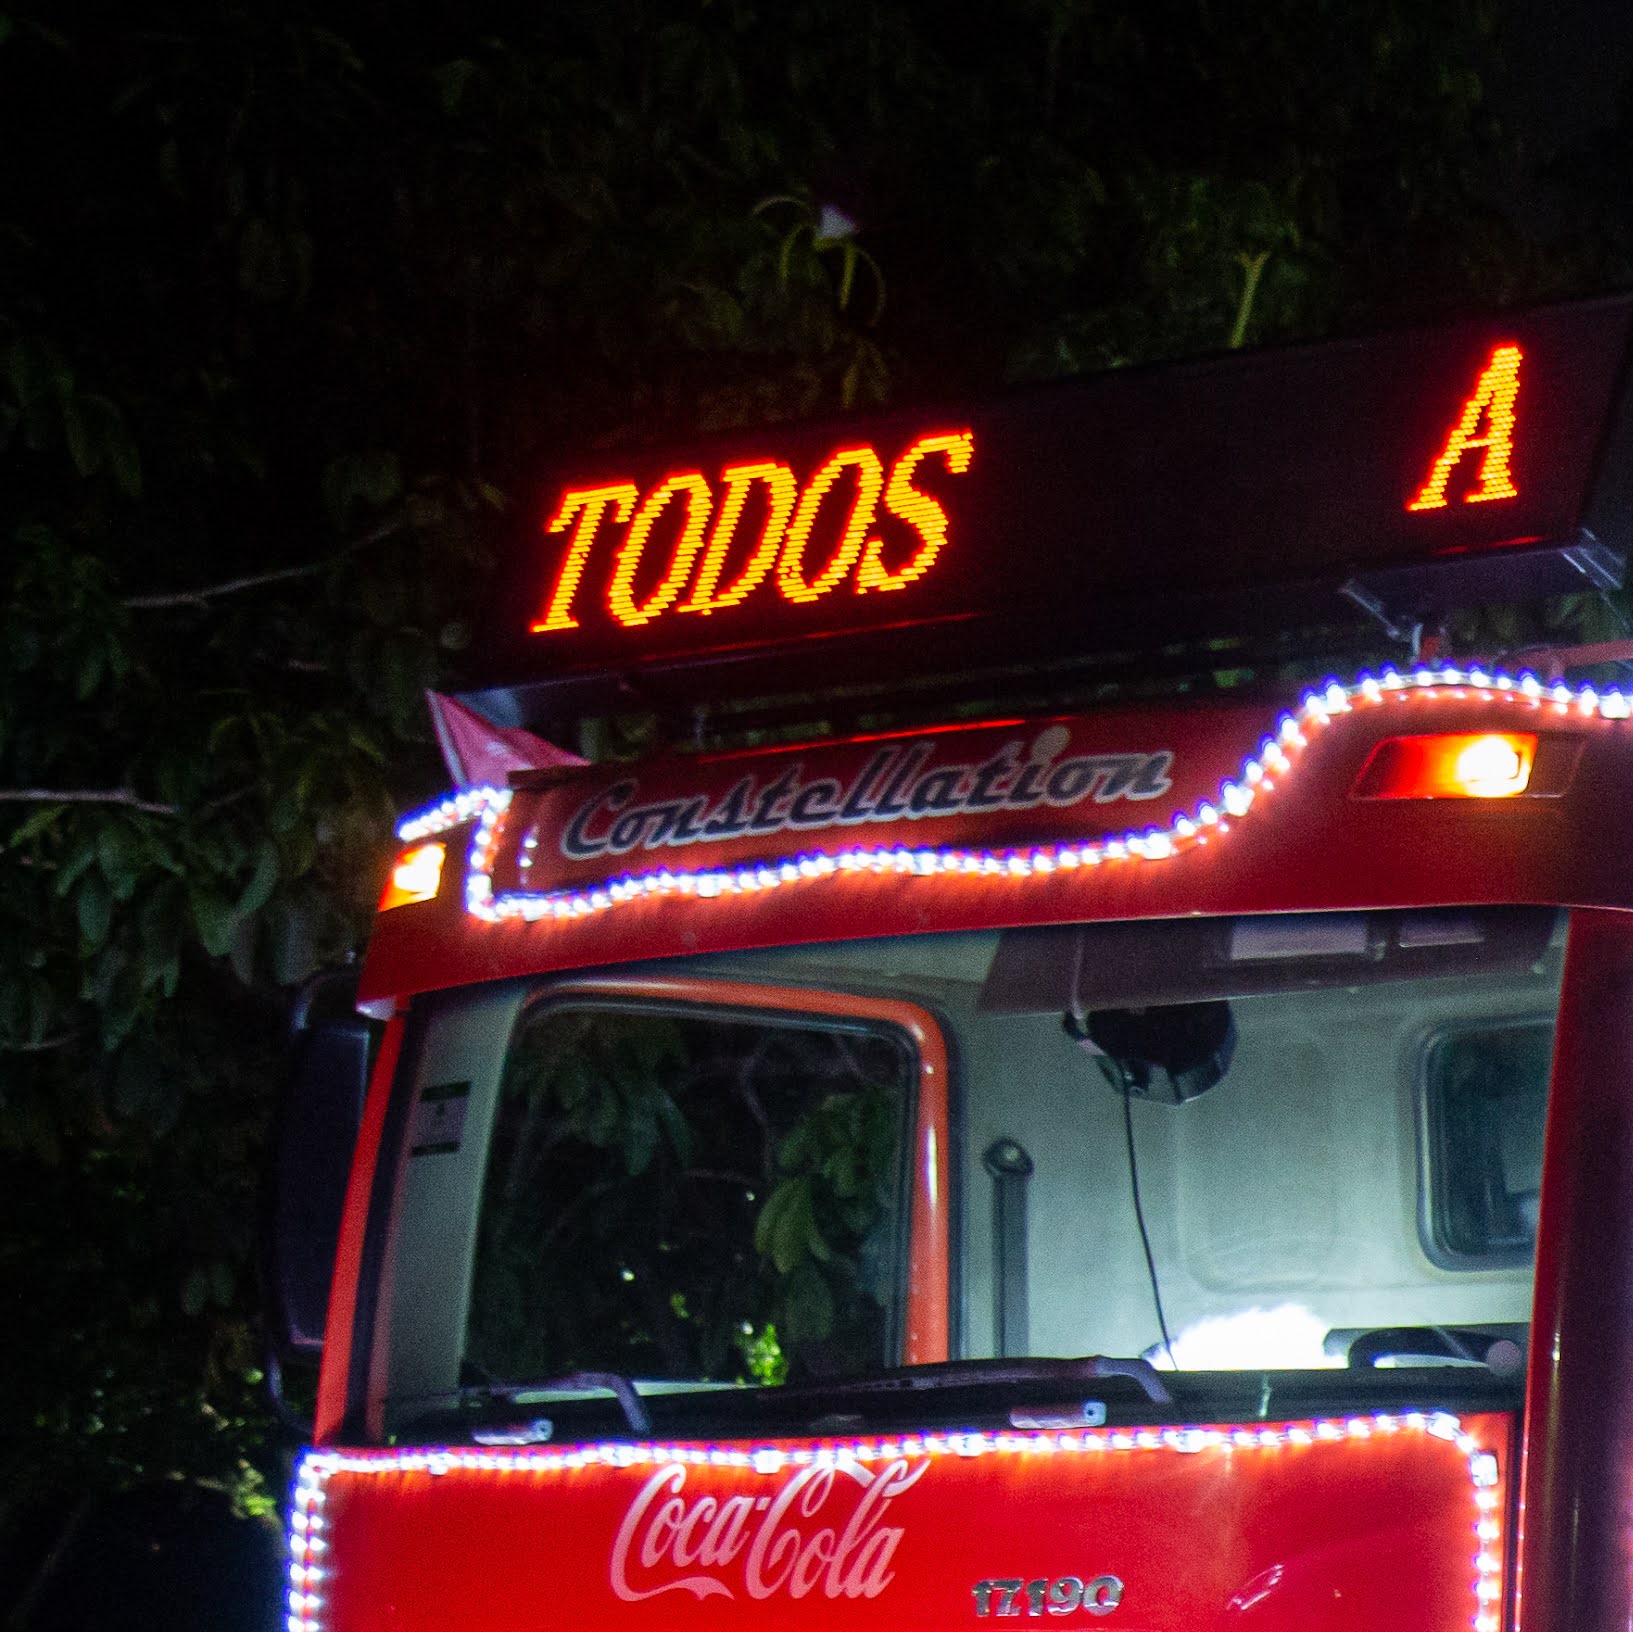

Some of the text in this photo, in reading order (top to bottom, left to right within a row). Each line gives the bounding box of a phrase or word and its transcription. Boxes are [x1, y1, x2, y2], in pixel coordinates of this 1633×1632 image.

[531, 341, 1523, 634] TODOS A
[560, 725, 1174, 860] Constellation
[610, 1456, 932, 1602] Coca-Cola
